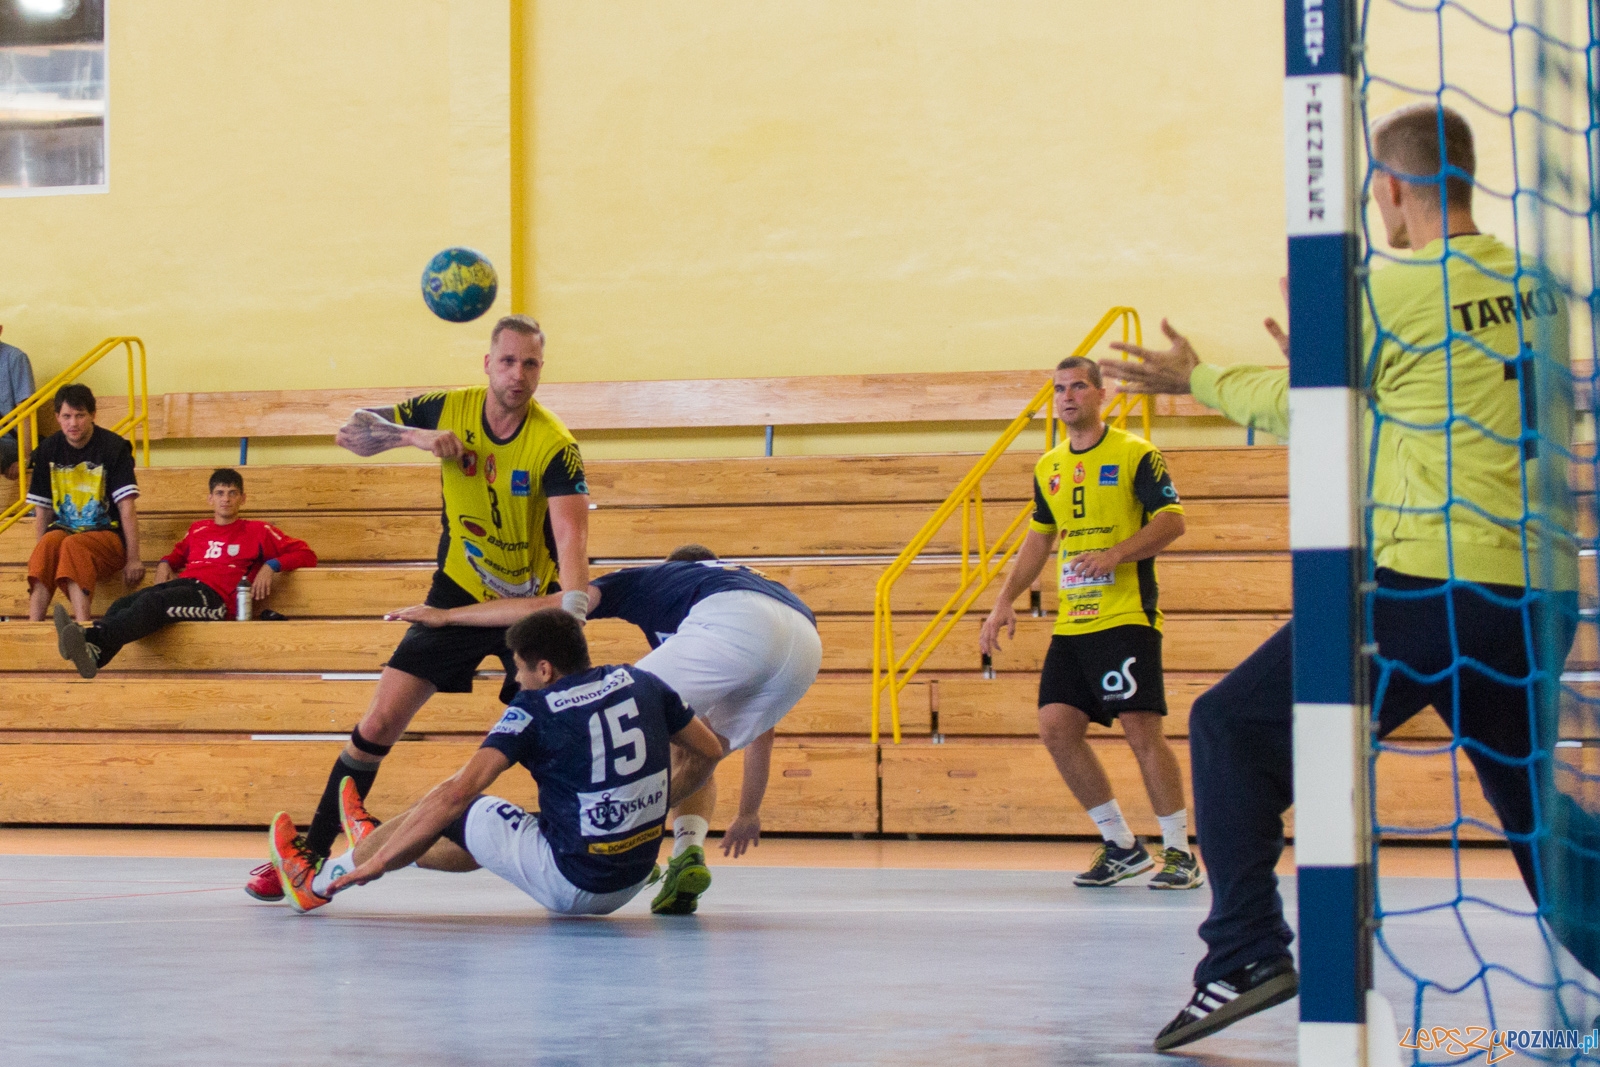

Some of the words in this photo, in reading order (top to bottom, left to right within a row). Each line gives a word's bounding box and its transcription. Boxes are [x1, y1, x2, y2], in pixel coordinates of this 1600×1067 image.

[1072, 486, 1085, 519] 9
[588, 697, 647, 784] 15
[586, 790, 663, 820] TRANSKAP
